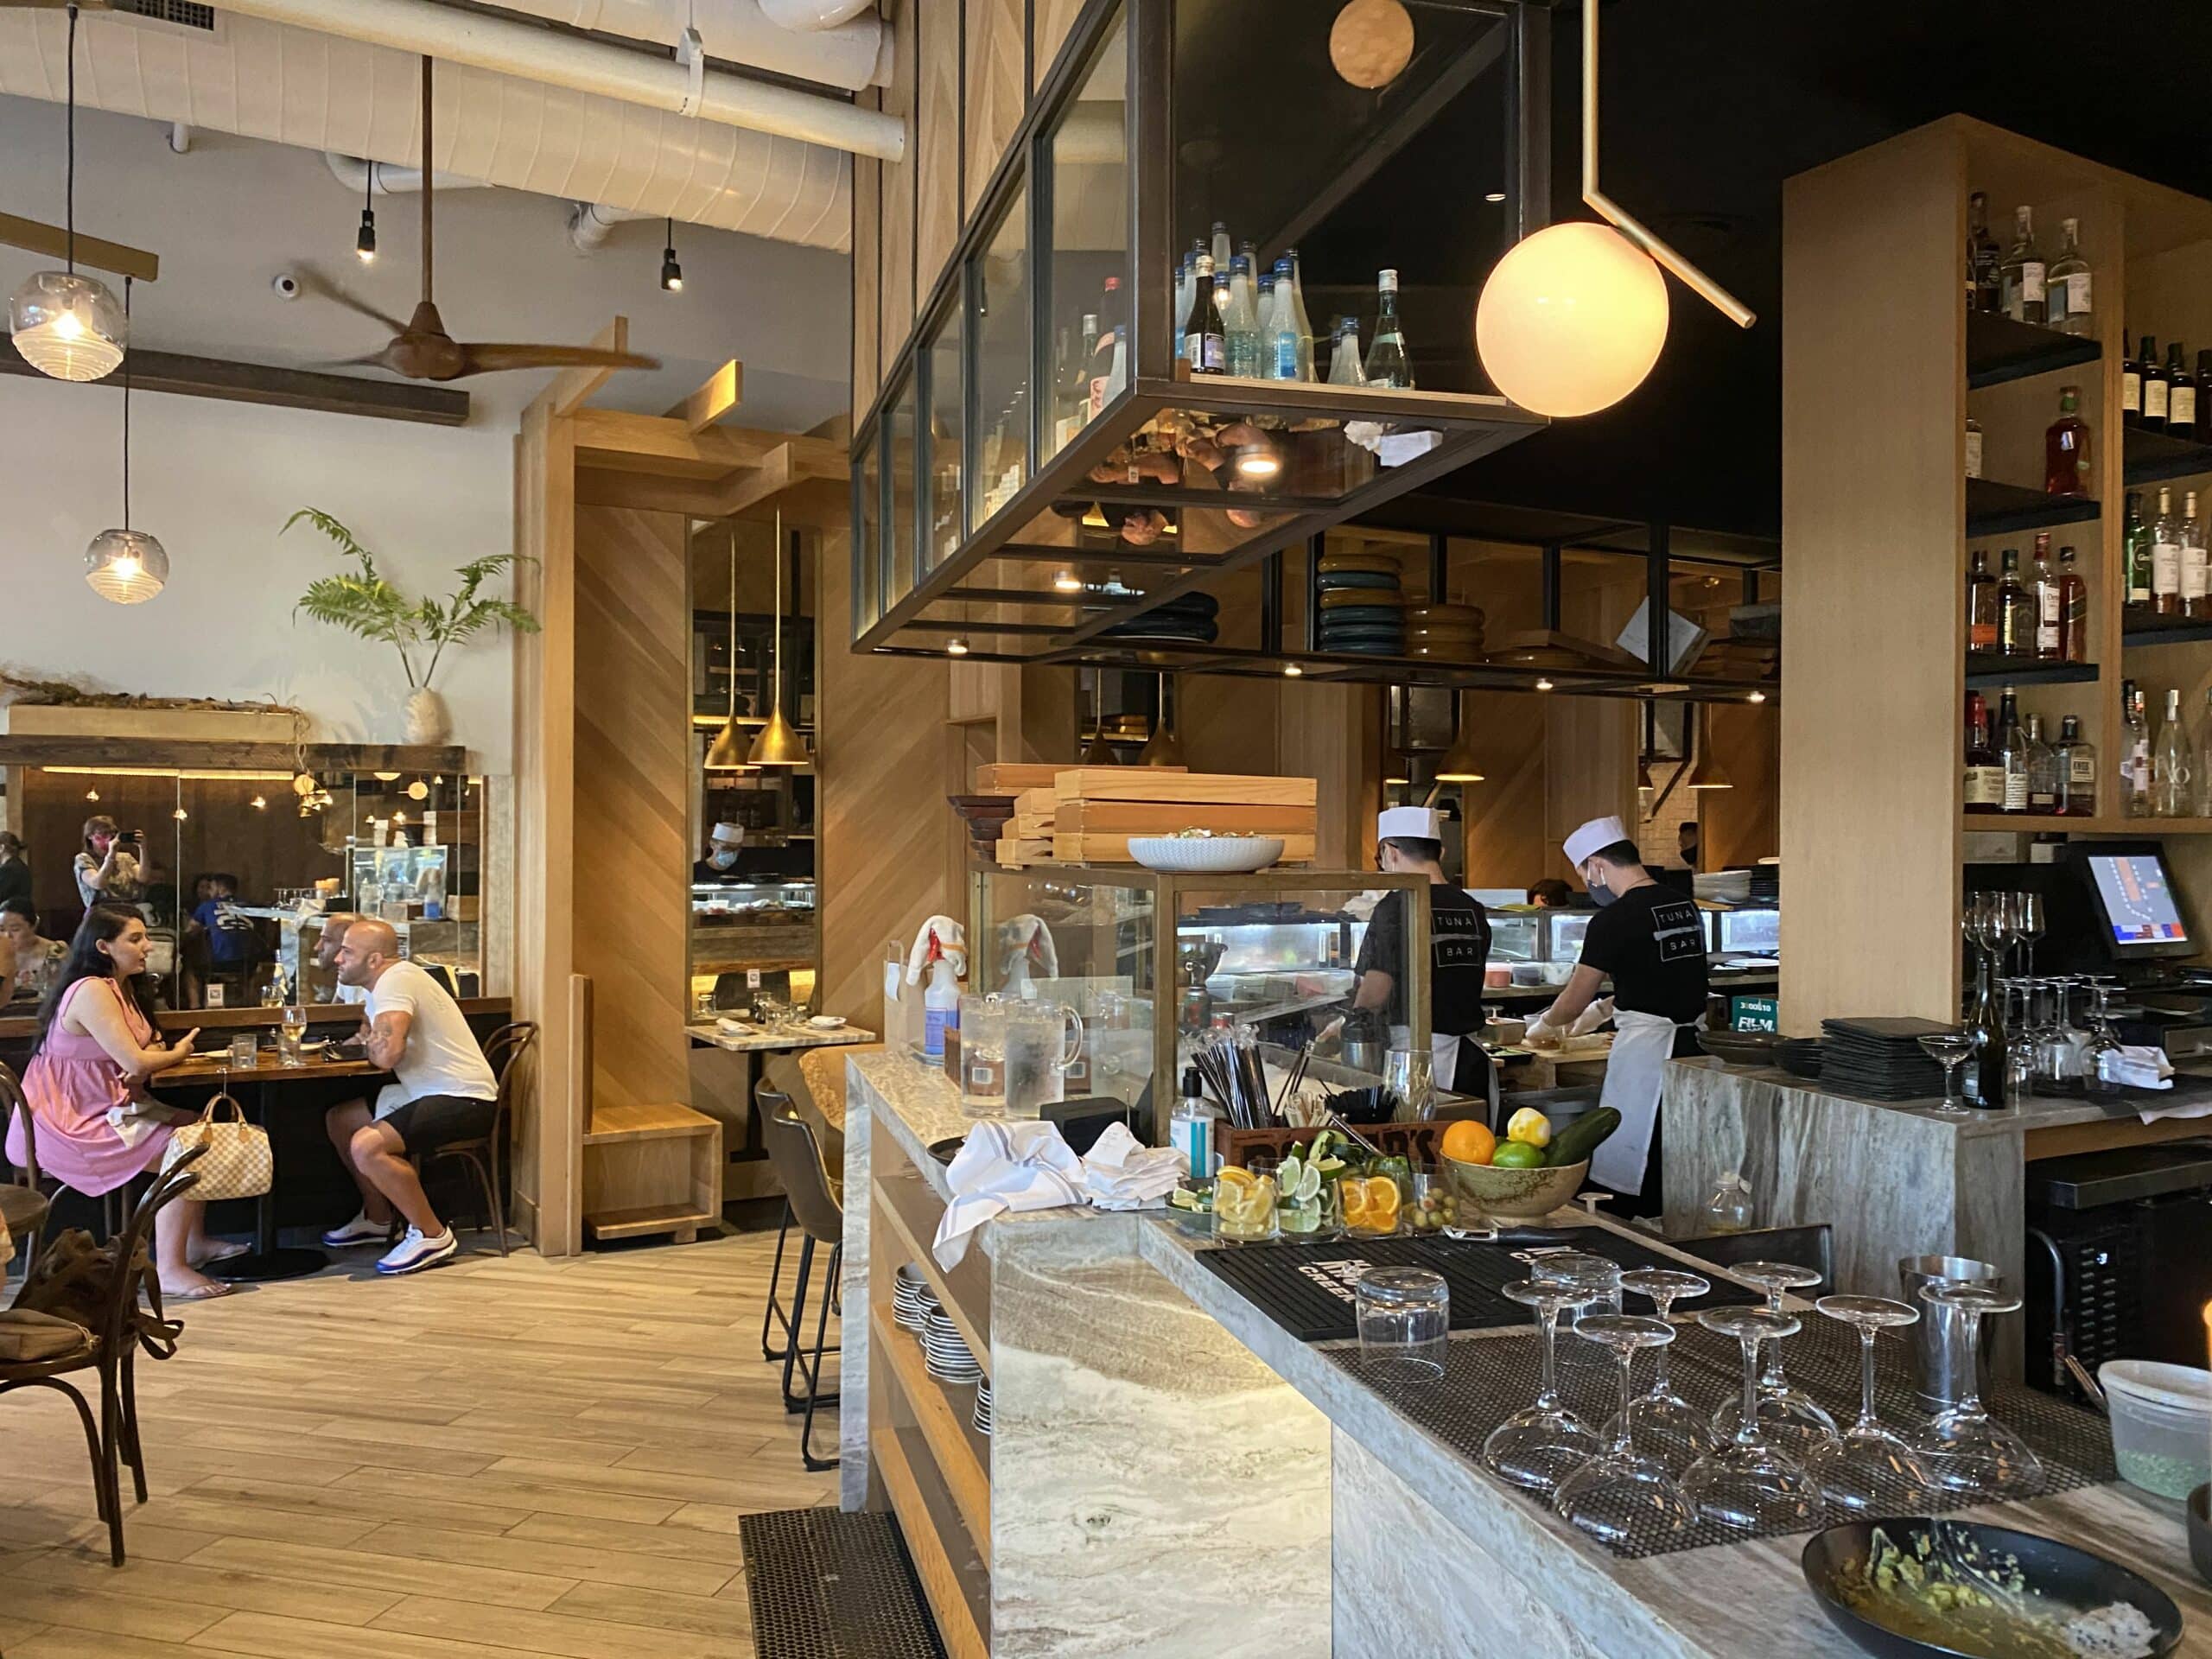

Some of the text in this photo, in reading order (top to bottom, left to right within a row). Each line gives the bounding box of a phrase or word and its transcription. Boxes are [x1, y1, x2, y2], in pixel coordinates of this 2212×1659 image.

[1437, 917, 1473, 926] TUNA
[1659, 910, 1694, 923] TUNA
[1669, 938, 1696, 951] BAR
[1446, 946, 1473, 957] BAR
